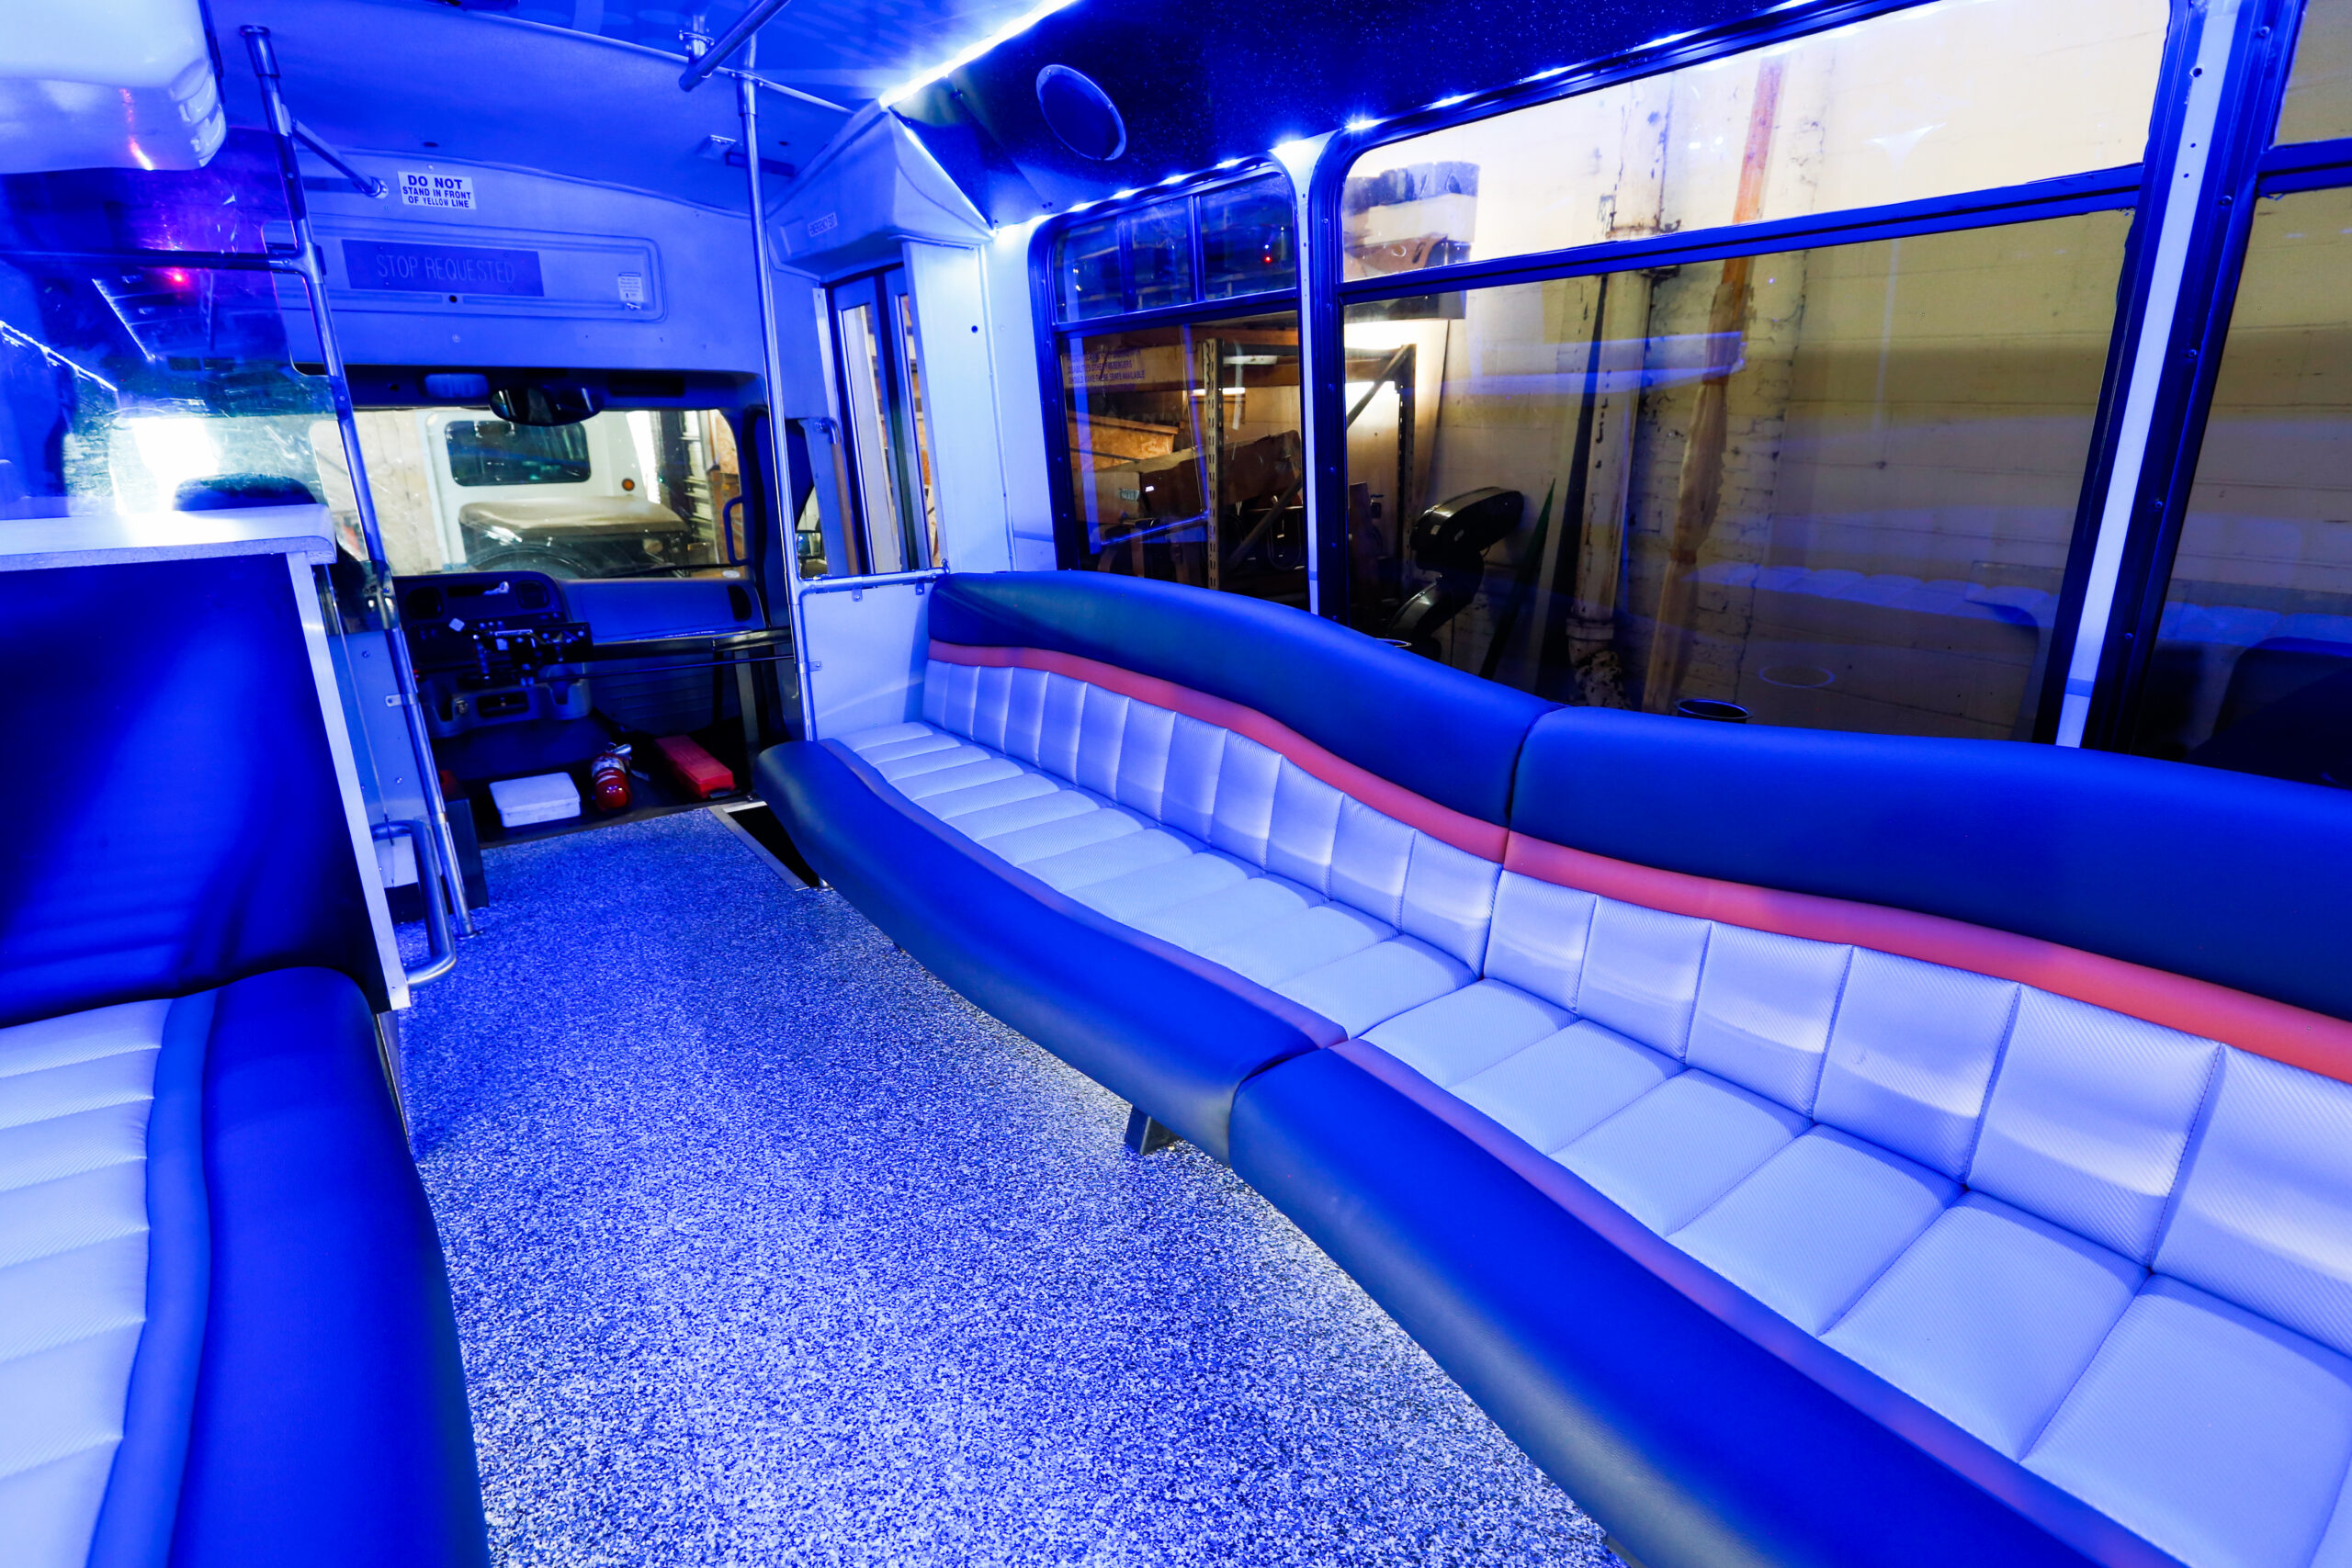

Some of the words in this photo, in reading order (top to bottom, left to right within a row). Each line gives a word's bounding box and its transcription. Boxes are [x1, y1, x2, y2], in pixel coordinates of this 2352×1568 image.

[407, 175, 428, 186] DO
[434, 177, 463, 189] NOT
[402, 186, 430, 197] STAND
[433, 188, 442, 197] IN
[444, 189, 471, 199] FRONT
[408, 195, 419, 204] OF
[423, 197, 448, 206] YELLOW
[451, 199, 469, 208] LINE
[376, 254, 418, 278] STOP
[424, 257, 515, 284] REQUESTED
